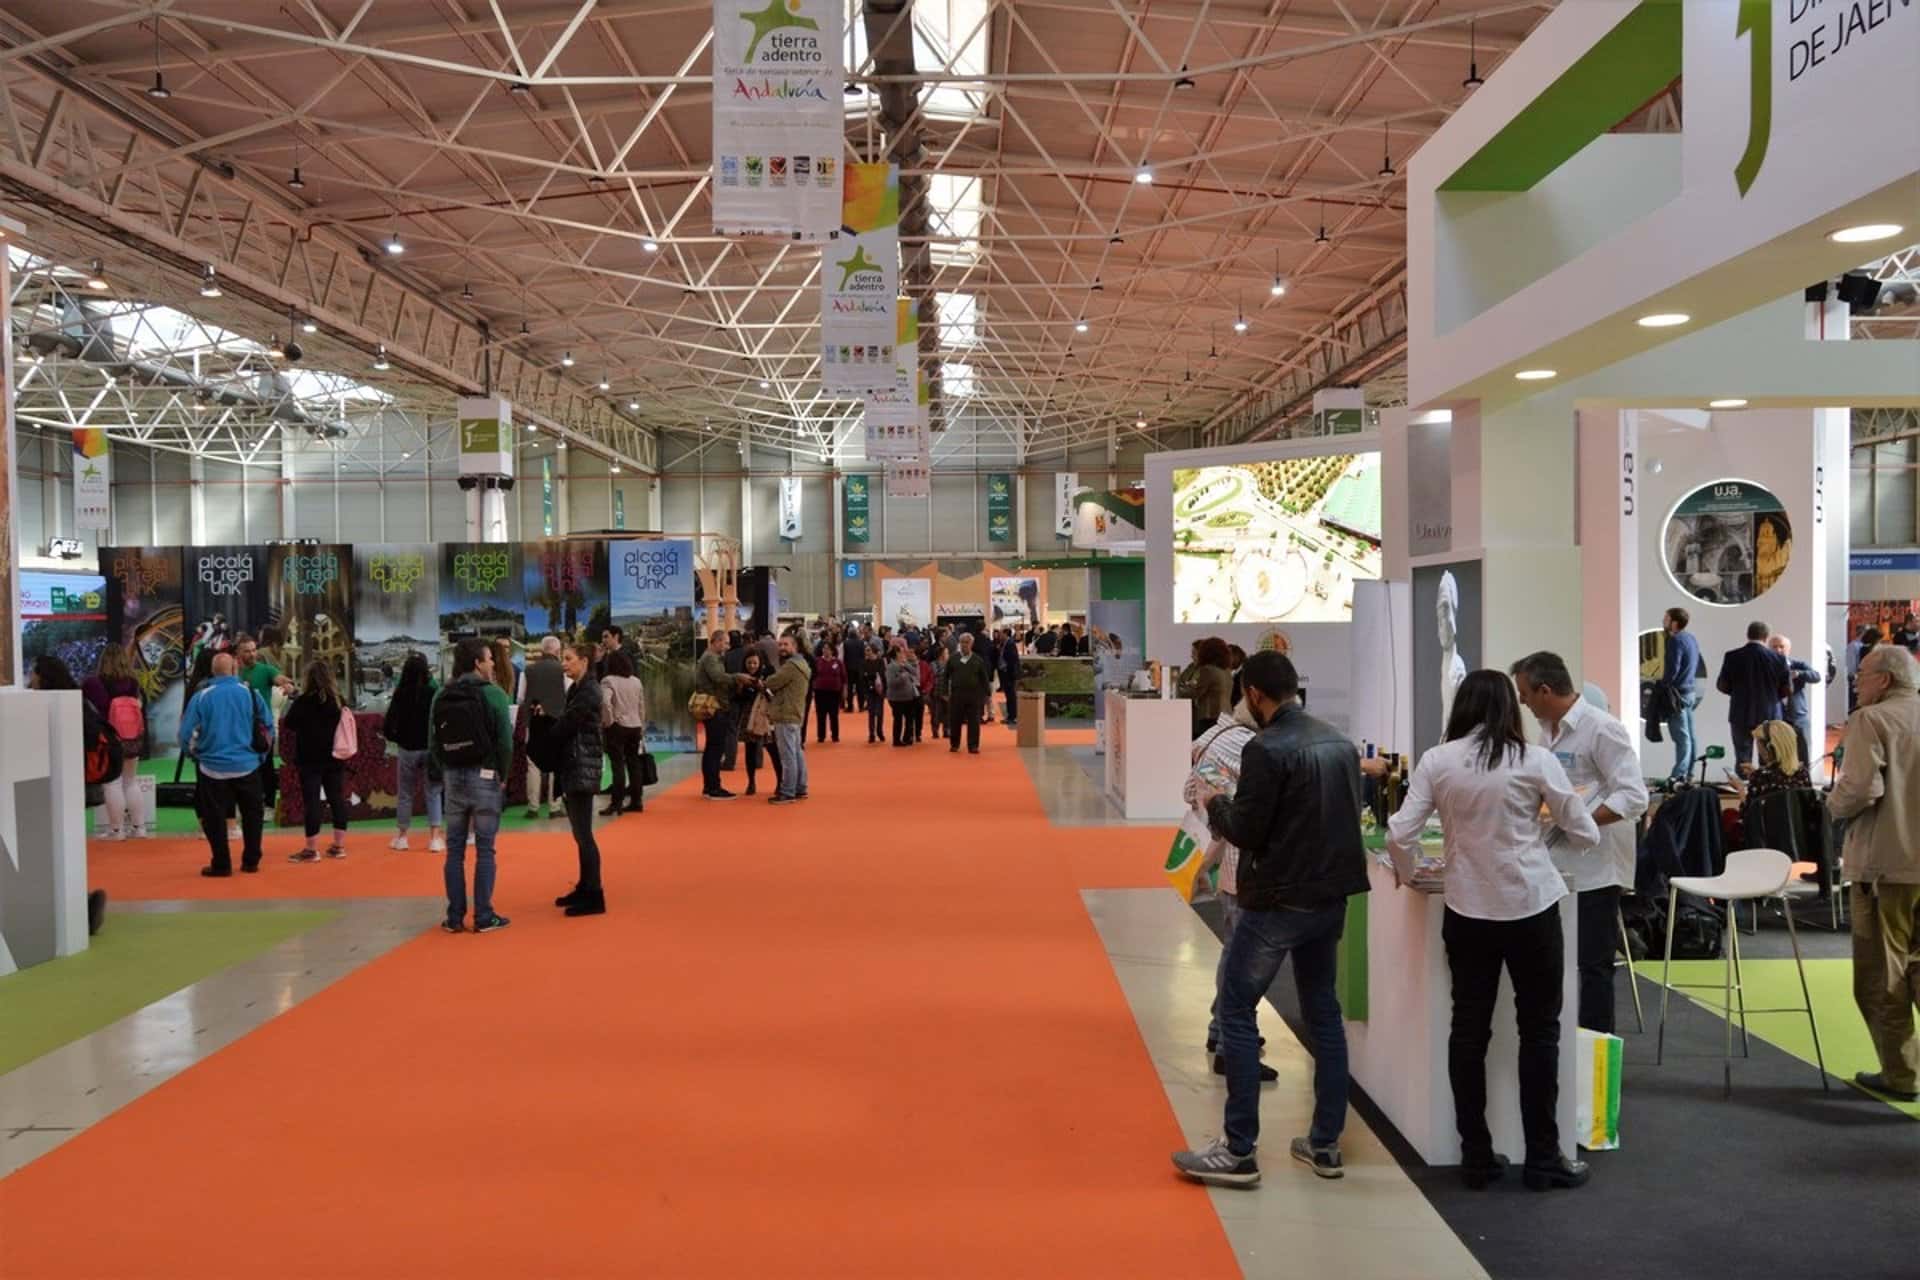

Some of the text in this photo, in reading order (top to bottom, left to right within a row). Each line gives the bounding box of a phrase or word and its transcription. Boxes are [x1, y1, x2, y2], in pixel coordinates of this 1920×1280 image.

[771, 33, 817, 48] tierra
[762, 49, 821, 62] adentro
[1790, 25, 1825, 81] DE
[854, 275, 882, 283] tierra
[849, 283, 885, 291] adentro
[199, 553, 253, 568] alcalá
[624, 548, 679, 563] alcalá
[199, 568, 253, 582] la real
[306, 568, 338, 582] real
[477, 565, 509, 578] real
[624, 563, 679, 576] la real
[846, 563, 857, 577] 5
